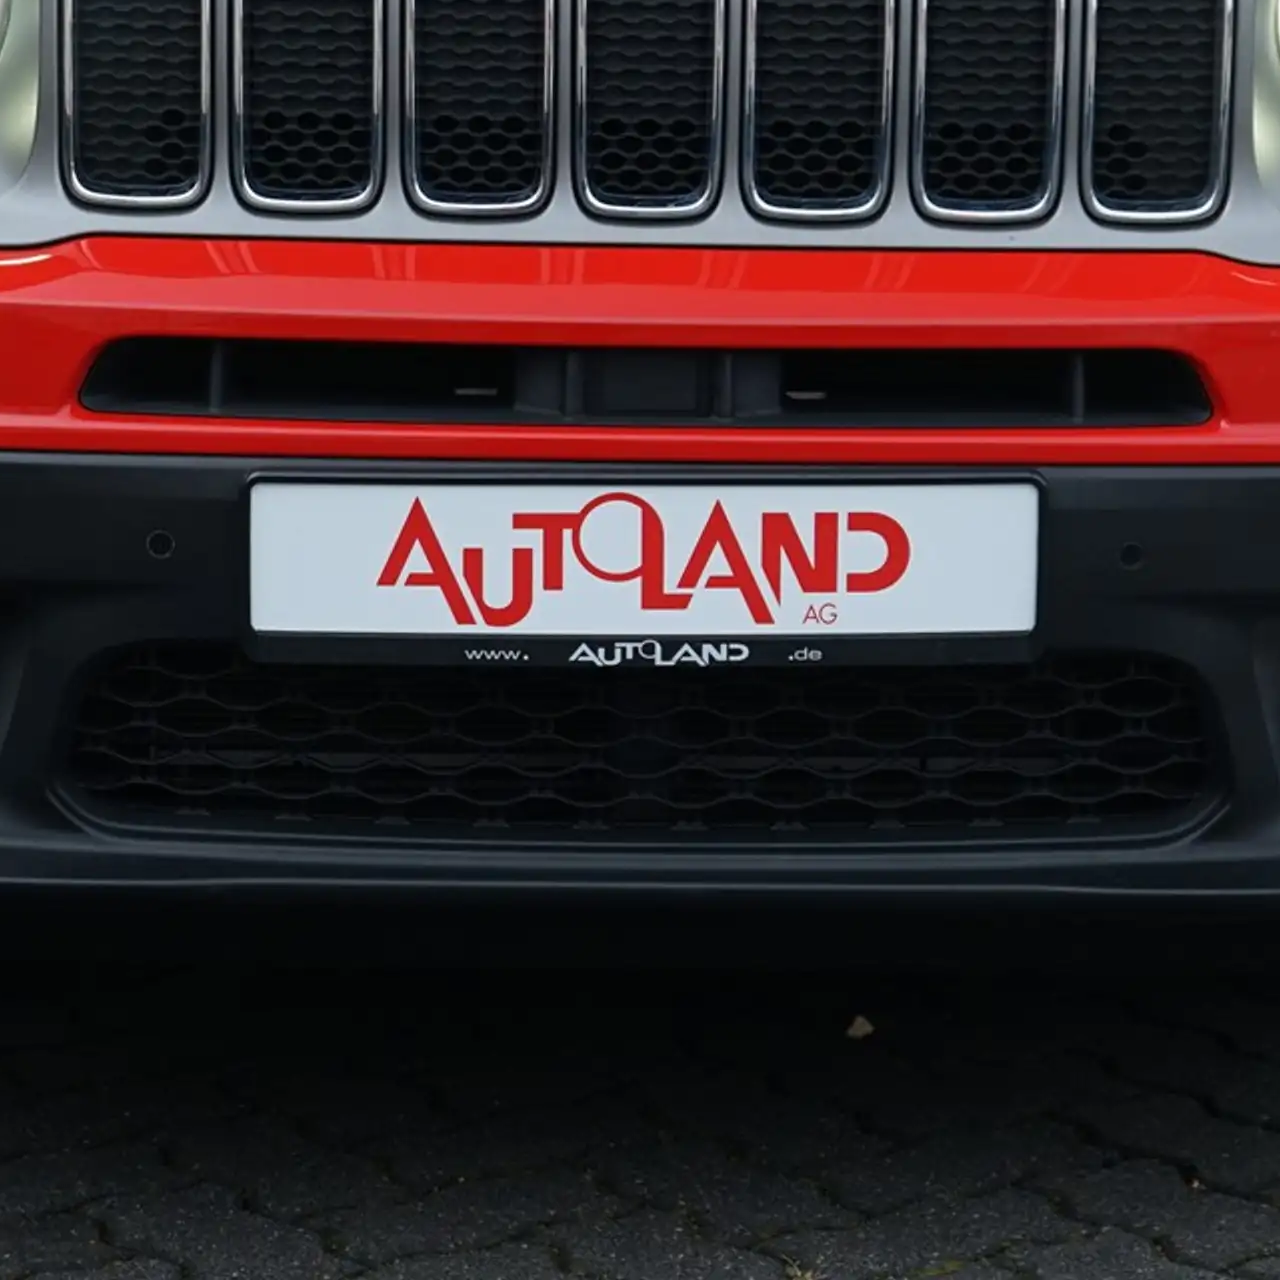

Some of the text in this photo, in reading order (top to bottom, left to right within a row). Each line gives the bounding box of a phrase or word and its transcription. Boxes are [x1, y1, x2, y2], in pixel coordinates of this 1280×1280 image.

[376, 491, 912, 628] AUTOLAND
[803, 603, 839, 625] AG
[464, 638, 823, 667] www. AUTOLAND .de
